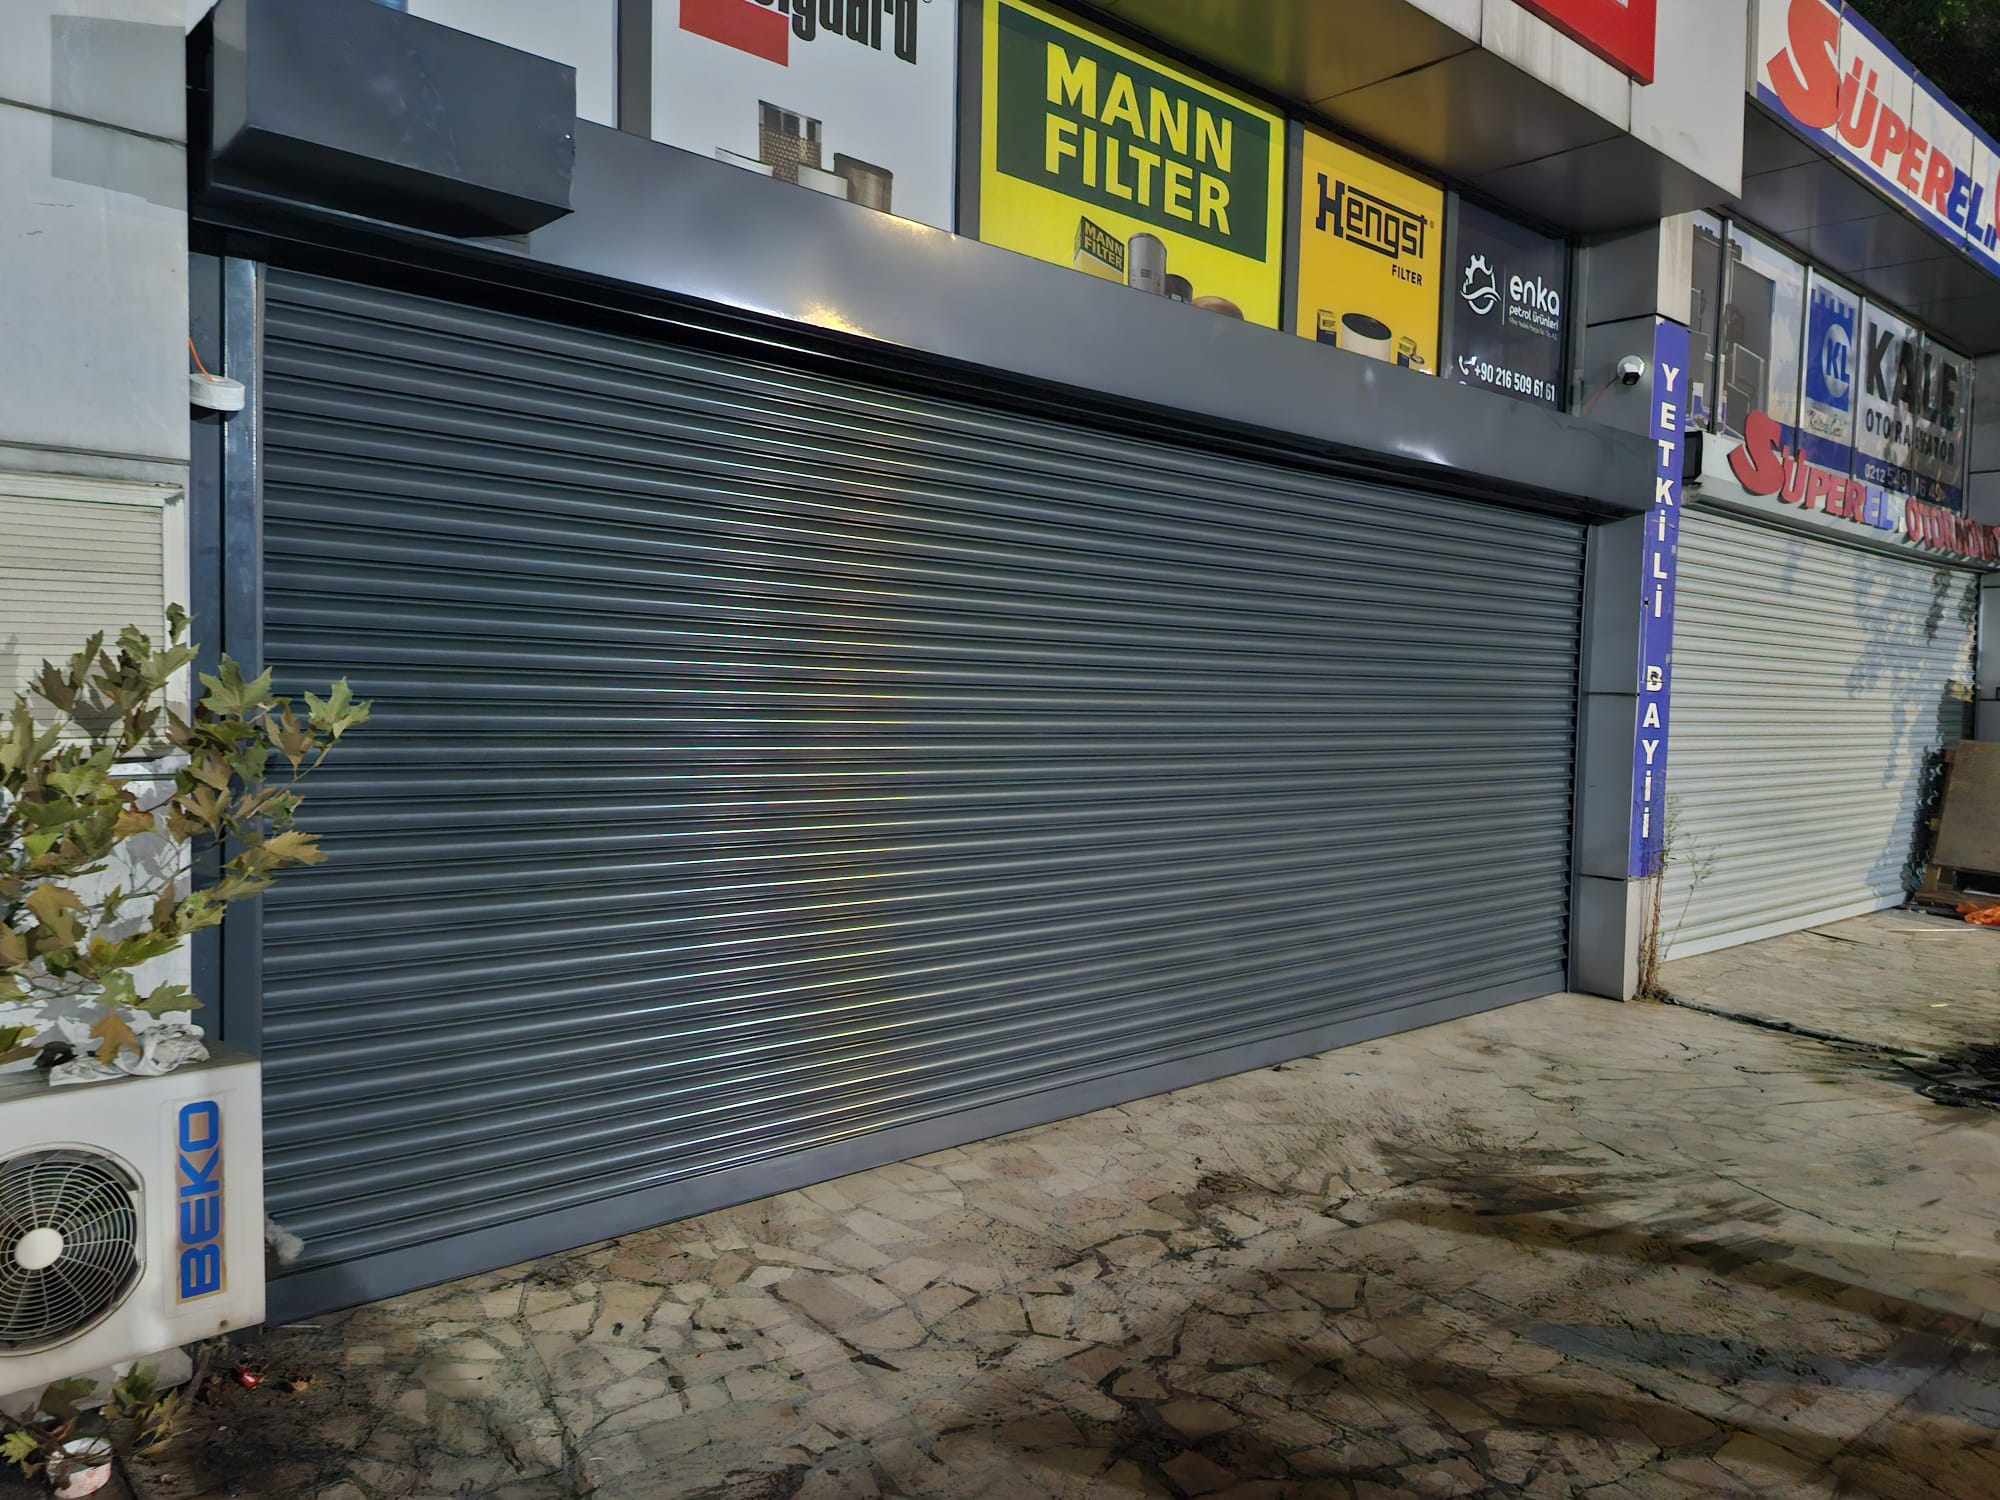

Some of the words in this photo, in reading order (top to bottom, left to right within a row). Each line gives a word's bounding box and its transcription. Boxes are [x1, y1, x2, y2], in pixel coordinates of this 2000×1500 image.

[754, 0, 918, 65] guard
[1046, 41, 1233, 173] MANN
[1044, 111, 1232, 236] FILTER
[1085, 221, 1123, 257] MANN
[1315, 172, 1428, 260] Hengst
[1084, 235, 1123, 270] FILTER
[1391, 264, 1423, 287] FILTER
[1509, 275, 1560, 317] enka
[1509, 304, 1532, 321] petrol
[1474, 361, 1494, 383] +90
[1495, 366, 1512, 389] 216
[1513, 372, 1532, 395] 509
[1533, 379, 1544, 399] 61
[1545, 382, 1555, 402] 61
[1825, 338, 1850, 384] KL
[1866, 321, 1959, 432] KALE
[1865, 408, 1891, 440] OTO
[1653, 363, 1680, 618] YETKİLİ
[1727, 410, 1894, 530] SÜPEREL
[1864, 463, 1886, 483] 0212
[1641, 665, 1664, 839] BAYİİ
[178, 1100, 222, 1300] BEKO
